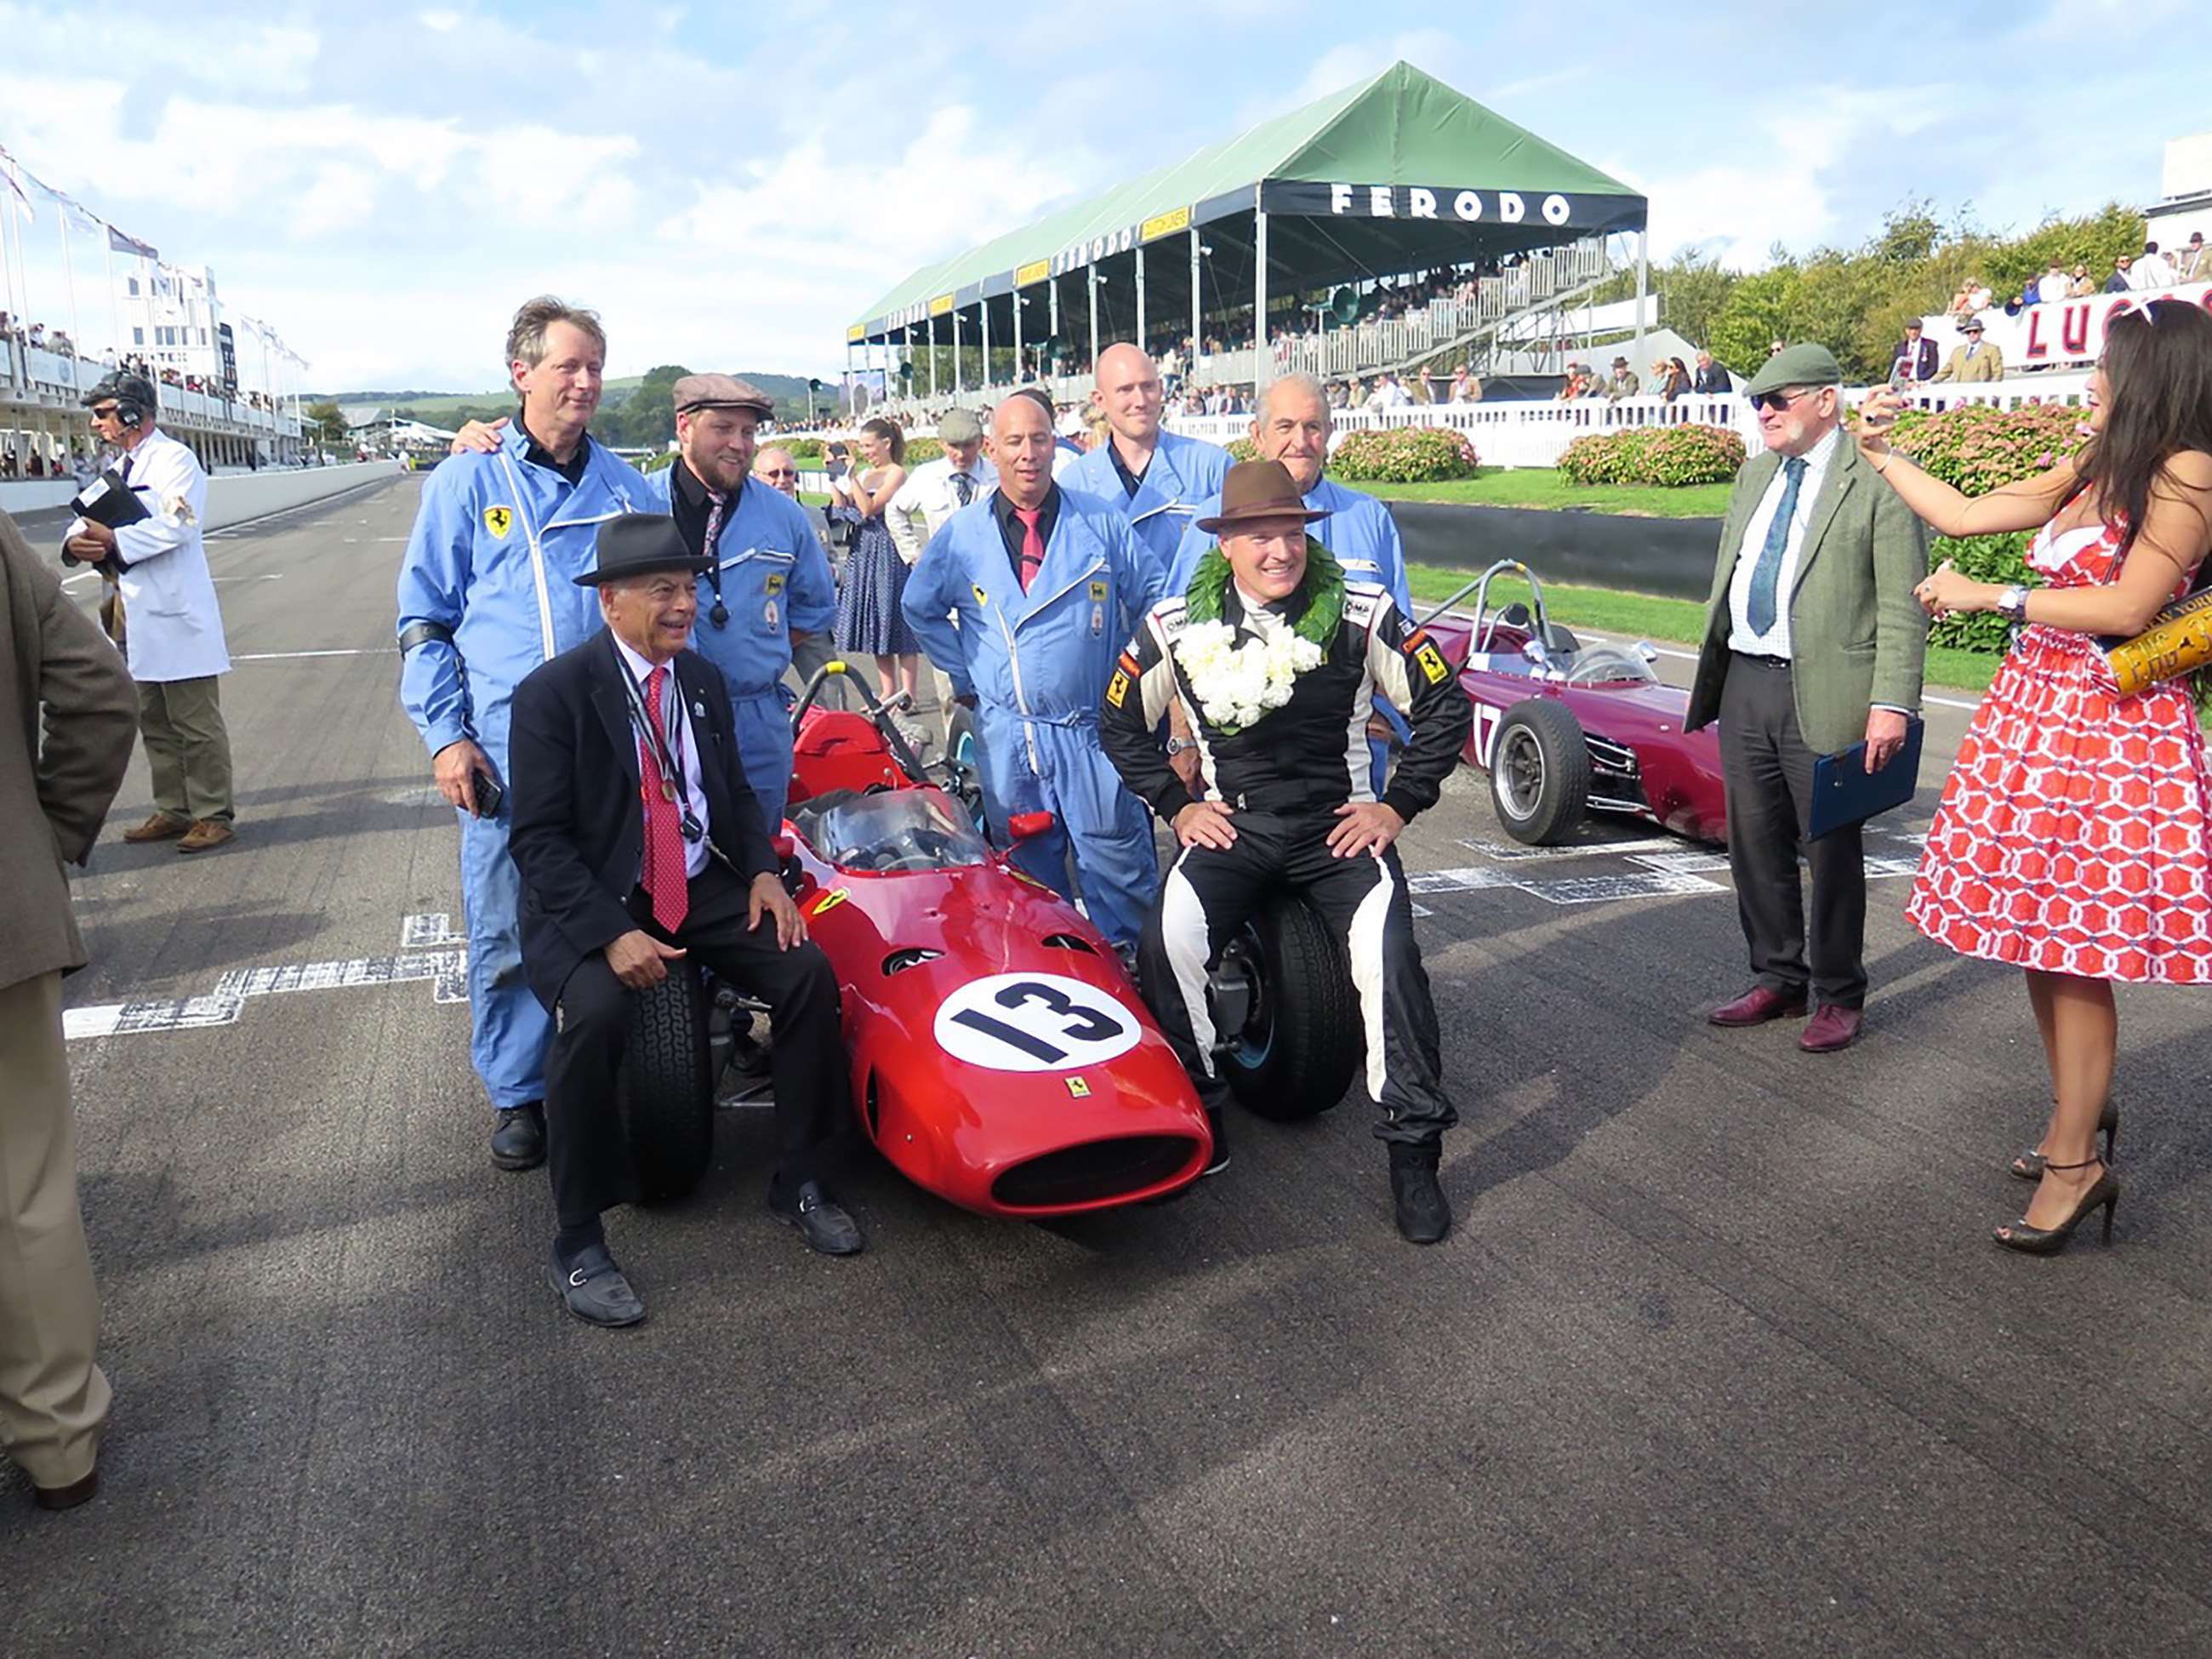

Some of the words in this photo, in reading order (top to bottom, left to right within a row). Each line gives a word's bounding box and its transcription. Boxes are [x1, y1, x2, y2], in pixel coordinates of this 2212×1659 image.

[1331, 184, 1571, 225] FERODO
[2027, 289, 2212, 358] LUC
[1474, 702, 1502, 769] 17
[950, 982, 1124, 1064] 13
